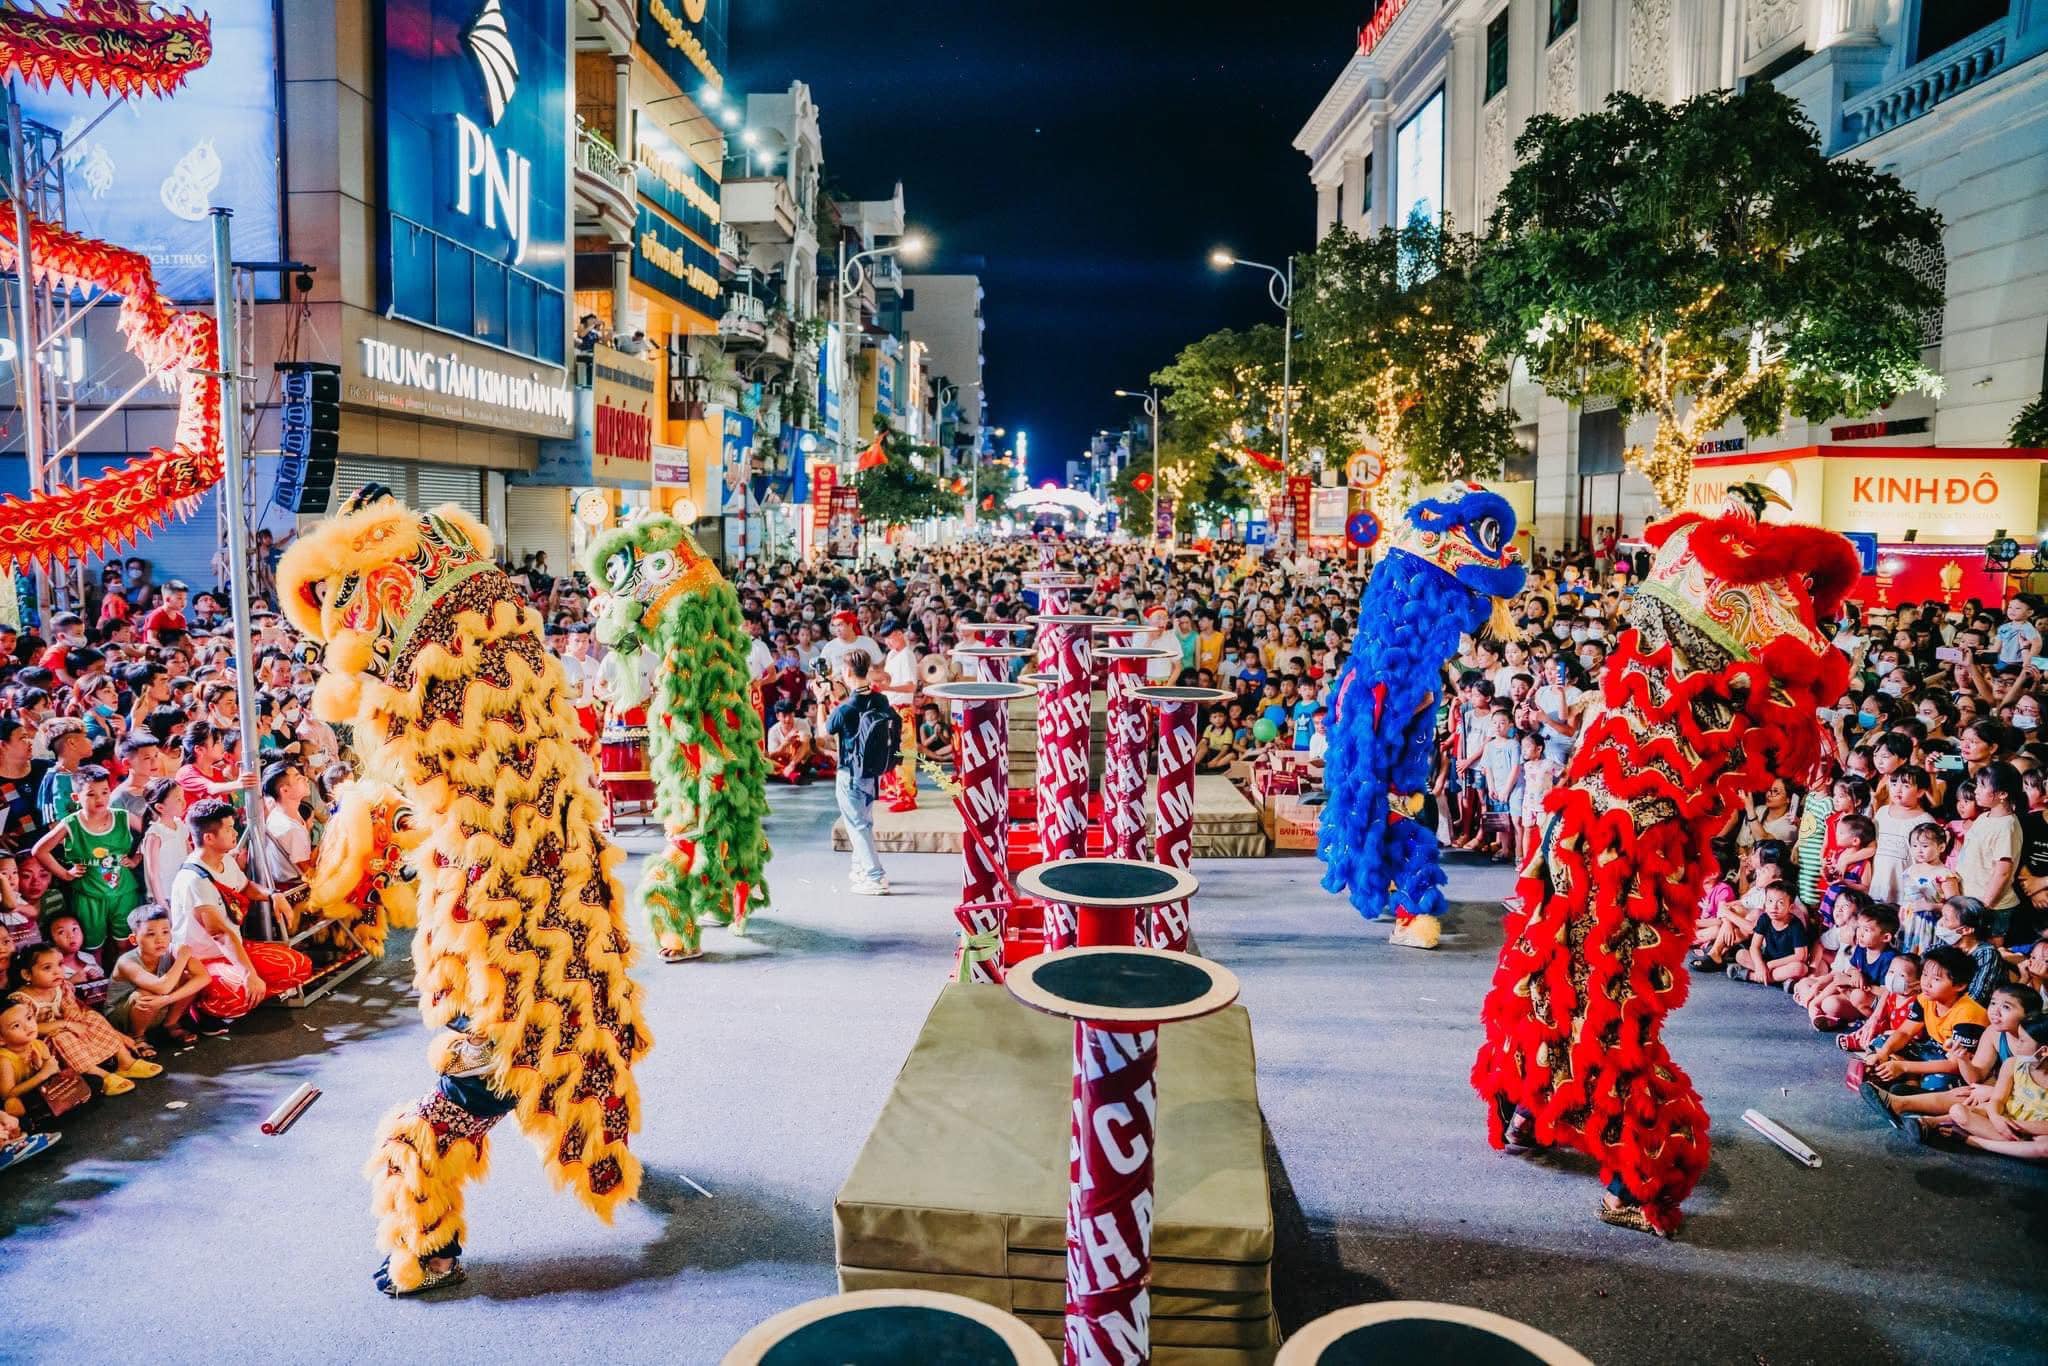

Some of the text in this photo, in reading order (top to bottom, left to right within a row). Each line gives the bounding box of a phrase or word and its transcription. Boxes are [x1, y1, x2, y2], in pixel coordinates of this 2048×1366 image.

[456, 113, 531, 266] PNJ
[360, 337, 437, 391] TRUNG
[437, 352, 477, 401] TÂM
[477, 367, 508, 408] KIM
[509, 372, 551, 415] HOÀN
[1853, 472, 1999, 505] KINH ĐÔ
[1251, 525, 1266, 540] P
